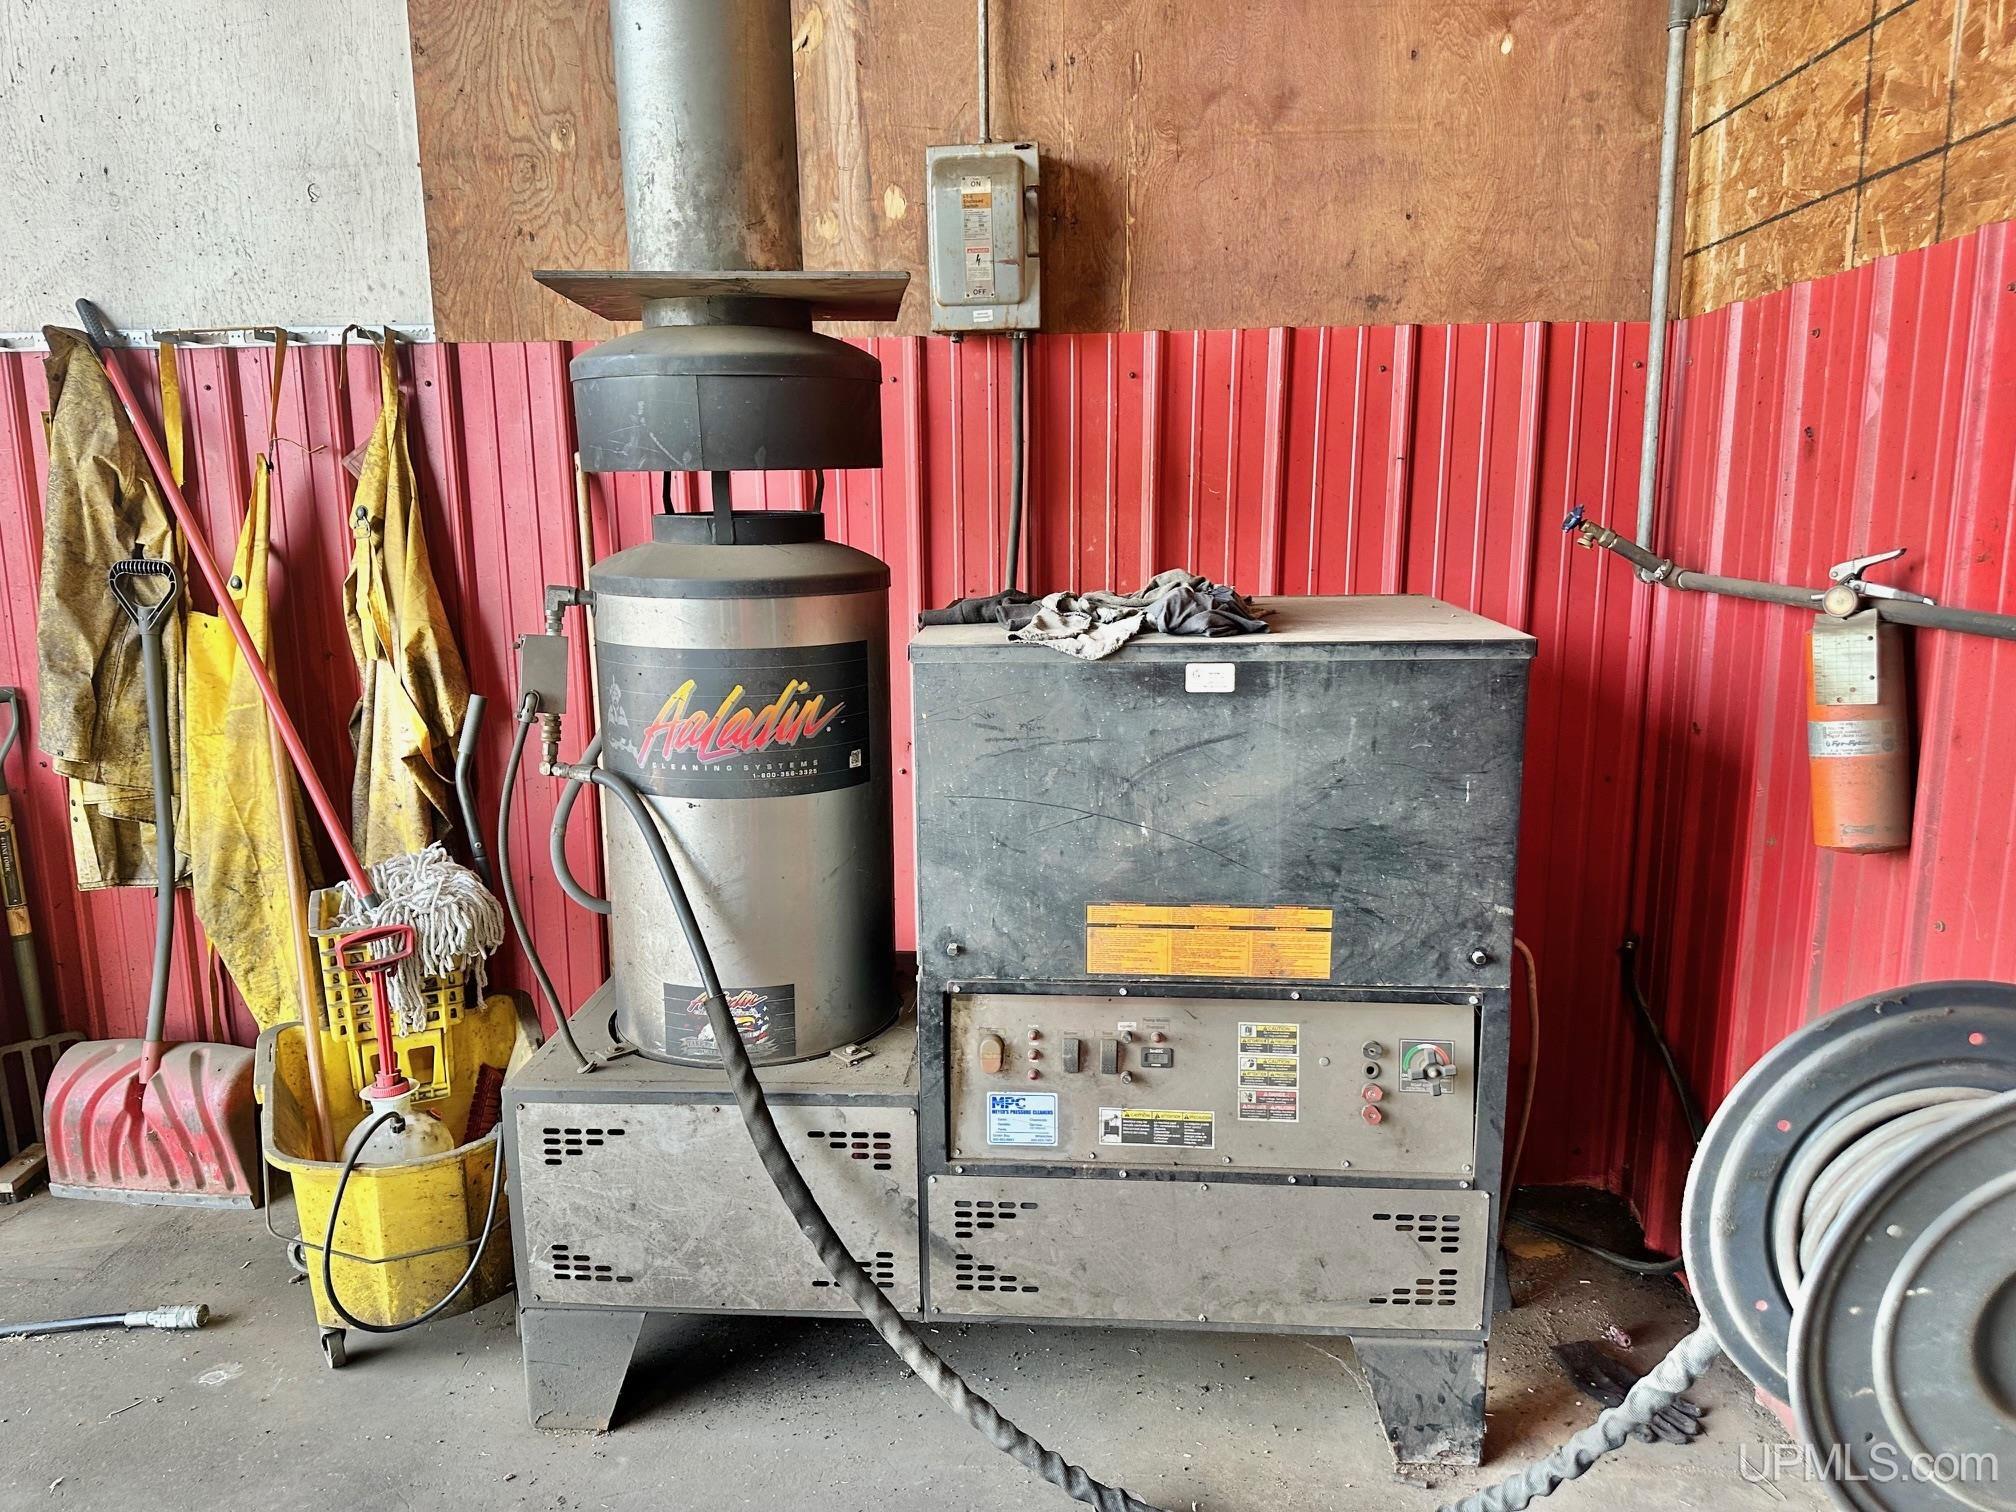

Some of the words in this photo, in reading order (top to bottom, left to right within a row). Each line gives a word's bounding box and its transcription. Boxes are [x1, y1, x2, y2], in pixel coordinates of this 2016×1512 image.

[970, 180, 982, 188] ON
[651, 762, 733, 772] CLEANING
[743, 759, 819, 772] SYSTEMS
[992, 1096, 1026, 1110] MPC
